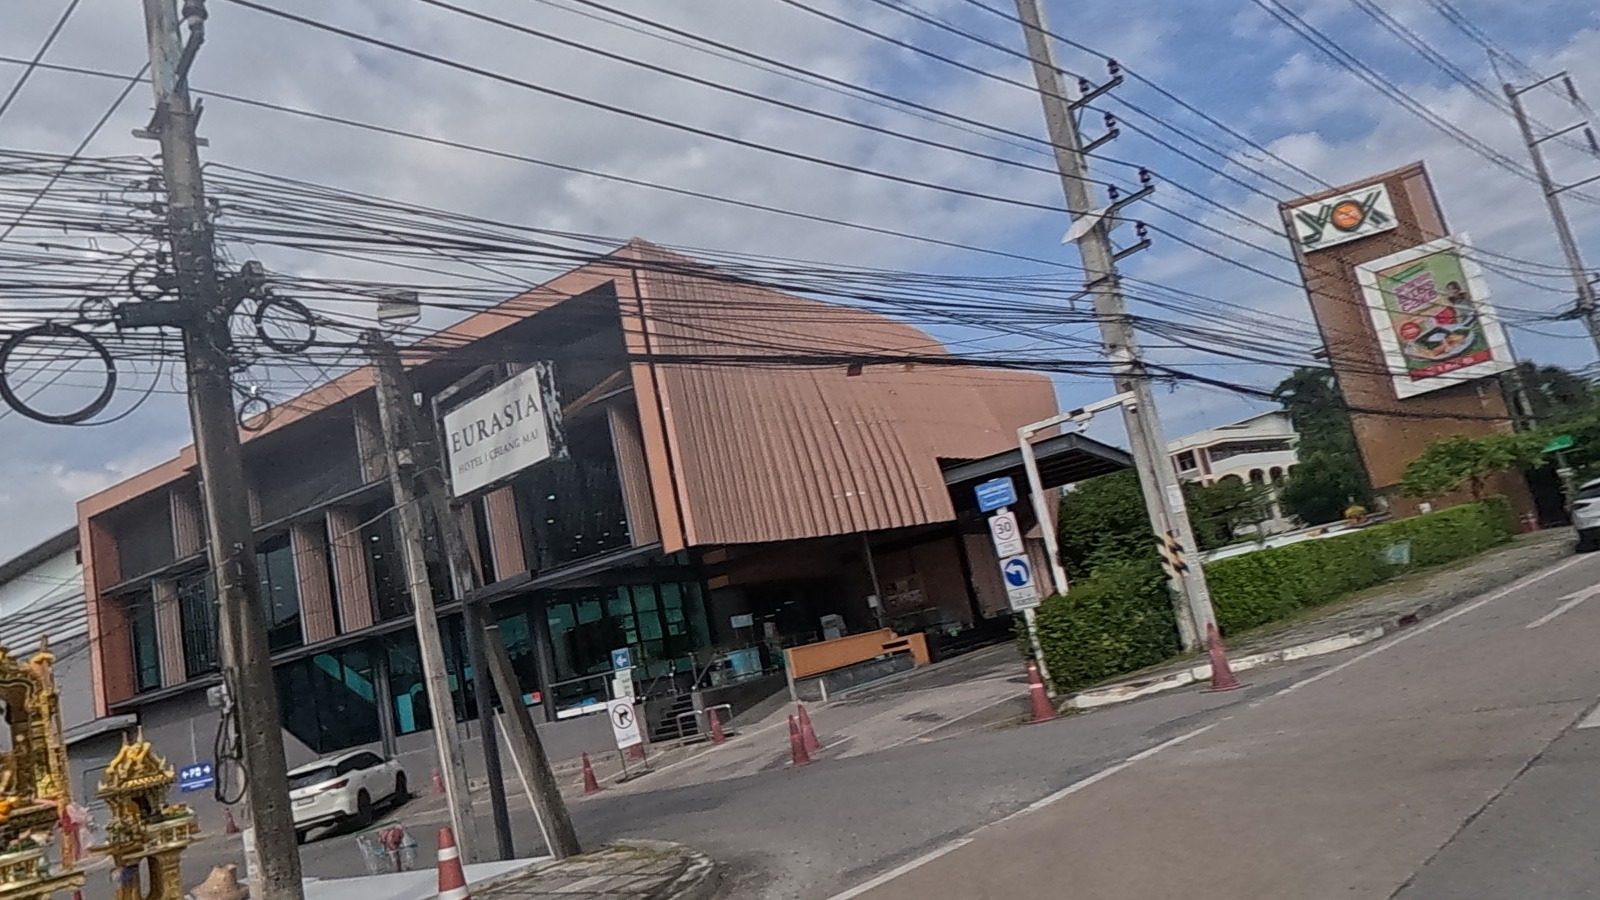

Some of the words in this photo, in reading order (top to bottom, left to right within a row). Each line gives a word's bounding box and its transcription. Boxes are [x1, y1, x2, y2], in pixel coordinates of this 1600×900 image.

[451, 394, 539, 454] EURASIA
[457, 456, 483, 474] HOTEL
[489, 439, 521, 461] CHIANG
[521, 429, 539, 444] MAI
[996, 521, 1012, 535] 30
